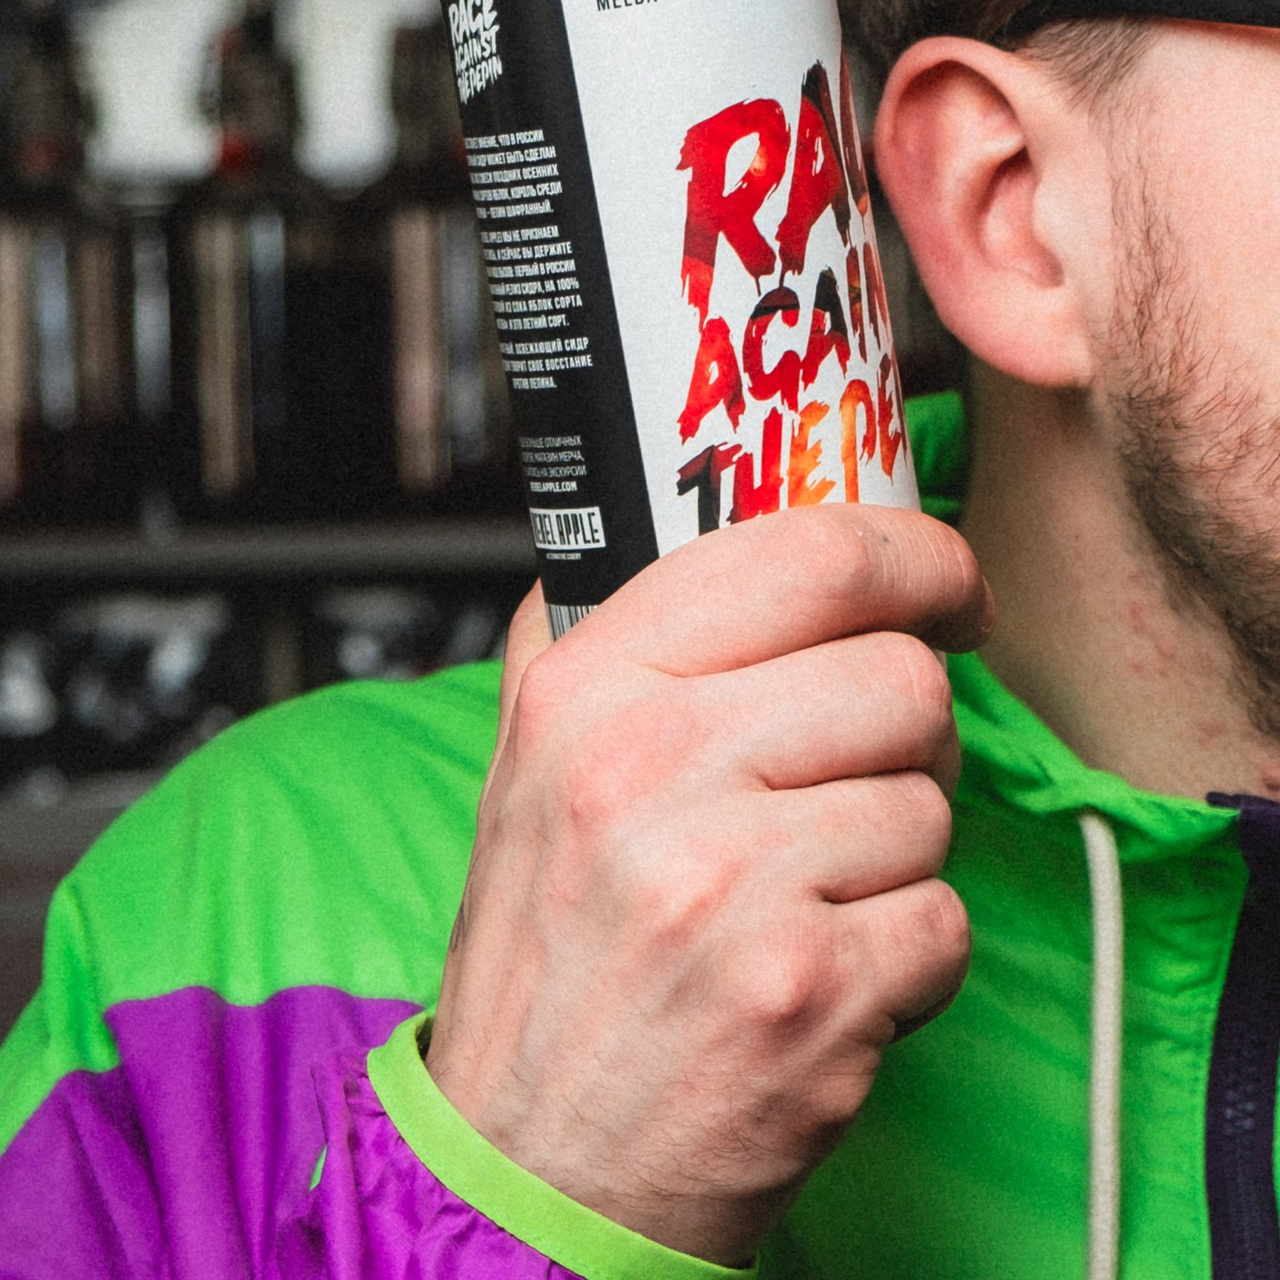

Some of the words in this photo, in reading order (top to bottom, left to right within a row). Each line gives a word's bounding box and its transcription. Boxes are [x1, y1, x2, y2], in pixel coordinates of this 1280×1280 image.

[516, 129, 545, 145] РОССИИ
[524, 146, 557, 162] СДЕЛАН
[522, 164, 559, 180] ОСЕННИХ
[536, 181, 563, 196] СРЕДИ
[521, 225, 559, 240] ПРИЗНАЕМ
[533, 241, 573, 258] ДЕРЖИТЕ
[539, 263, 546, 275] В
[546, 259, 576, 274] РОССИИ
[544, 280, 556, 292] НА
[556, 277, 580, 292] 100%
[528, 297, 554, 312] ЯБЛОК
[554, 294, 583, 310] СОРТА
[547, 314, 570, 327] СОРТ.
[515, 338, 563, 355] ОСВЕЖАЮЩИЙ
[563, 336, 590, 352] СИДР
[527, 358, 545, 372] СВОЕ
[544, 354, 593, 372] ВОССТАНИЕ
[556, 511, 600, 546] APPLE
